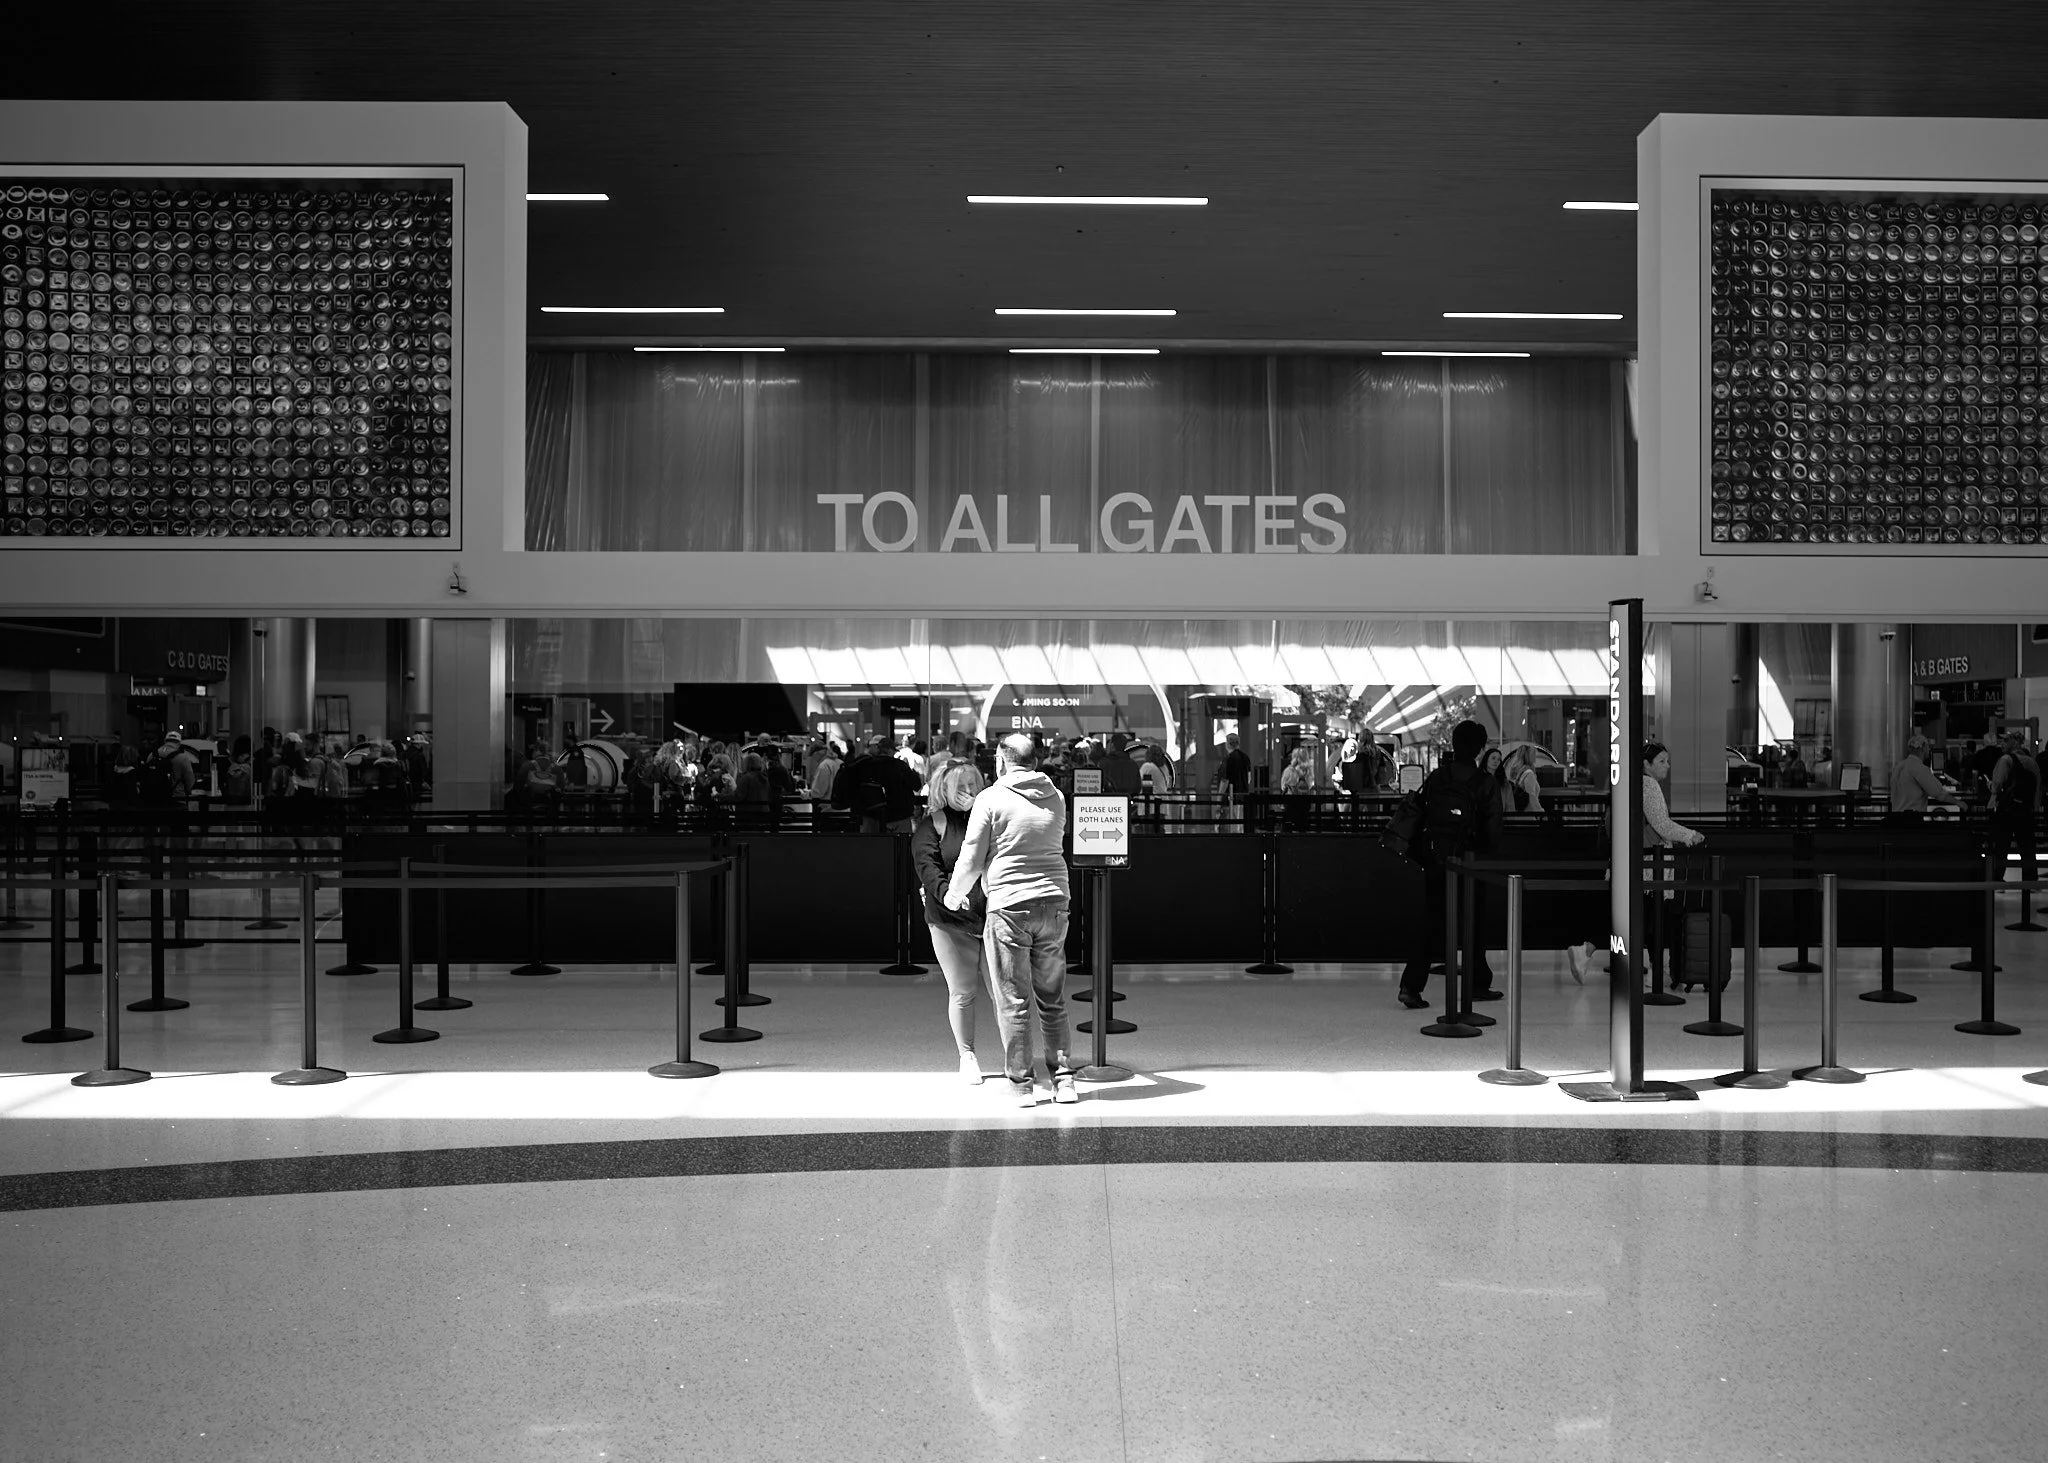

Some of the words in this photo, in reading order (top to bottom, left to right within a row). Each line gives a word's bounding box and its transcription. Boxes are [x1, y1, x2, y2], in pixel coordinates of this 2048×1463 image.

[816, 491, 919, 552] TO
[939, 494, 1079, 552] ALL
[1099, 491, 1347, 554] GATES
[168, 650, 177, 668] C
[178, 651, 186, 669] &
[187, 652, 196, 669] D
[197, 653, 229, 672] GATES
[1920, 660, 1927, 676] &
[1928, 659, 1935, 675] B
[1936, 656, 1968, 675] GATES
[1052, 697, 1080, 707] SOON
[1609, 619, 1620, 786] STANDARD
[1610, 934, 1628, 956] NA
